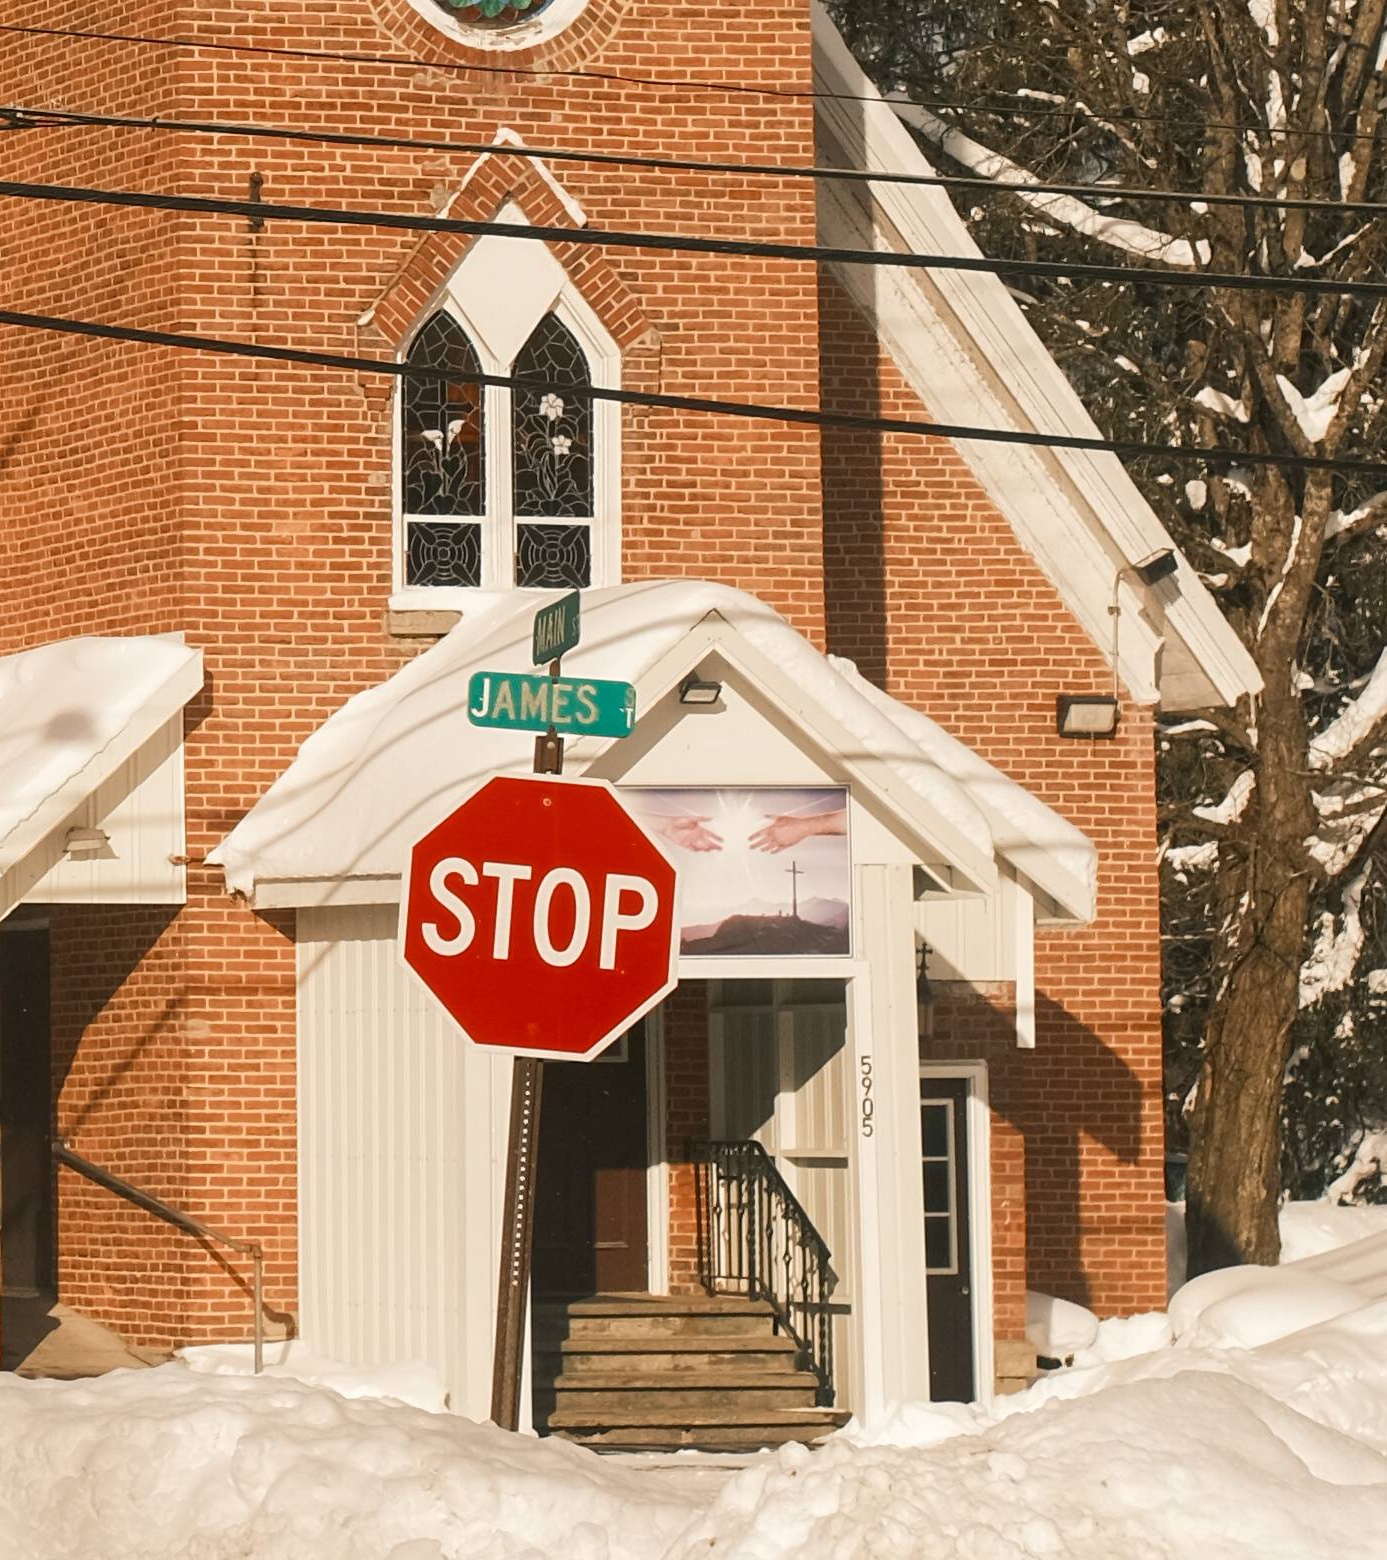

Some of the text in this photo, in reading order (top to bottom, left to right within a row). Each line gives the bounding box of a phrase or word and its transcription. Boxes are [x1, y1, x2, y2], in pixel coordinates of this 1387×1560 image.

[536, 606, 566, 656] MAIN
[471, 678, 599, 725] JAMES
[421, 856, 659, 971] STOP
[860, 1055, 874, 1138] 5905
